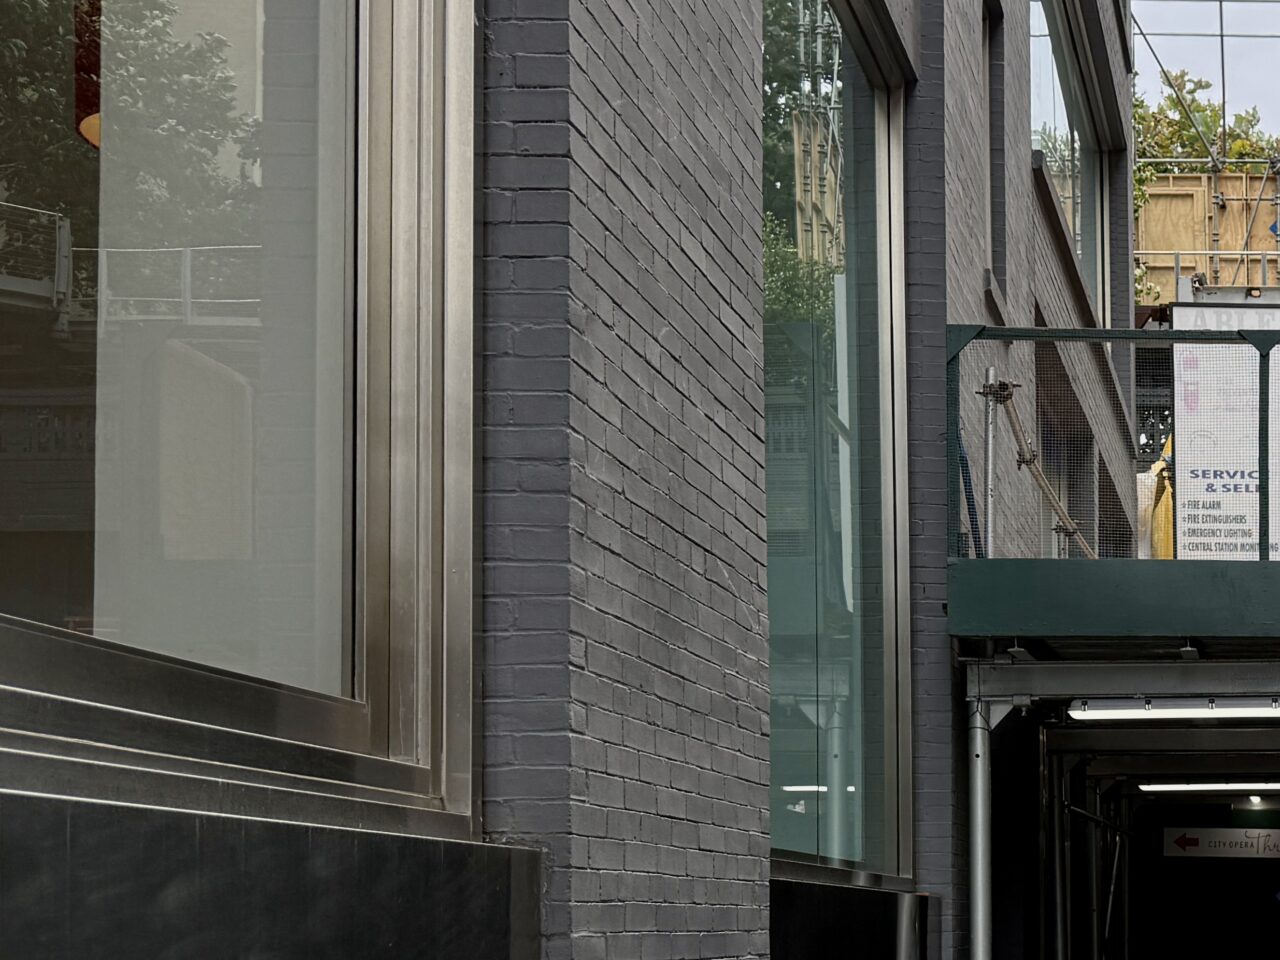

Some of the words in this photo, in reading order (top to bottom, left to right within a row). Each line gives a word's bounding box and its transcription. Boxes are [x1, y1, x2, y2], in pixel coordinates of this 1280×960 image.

[1205, 483, 1217, 493] &
[1187, 500, 1200, 509] FIRE
[1201, 500, 1221, 510] ALARM
[1187, 514, 1200, 524] FIRE
[1201, 514, 1247, 524] EXTINGUISHERS
[1187, 528, 1223, 538] EMERGENCY
[1224, 528, 1252, 538] LIGHTING
[1188, 542, 1213, 551] CENTRAL
[1214, 542, 1238, 552] STATION
[1208, 840, 1227, 848] CITY
[1229, 840, 1255, 849] OPERA
